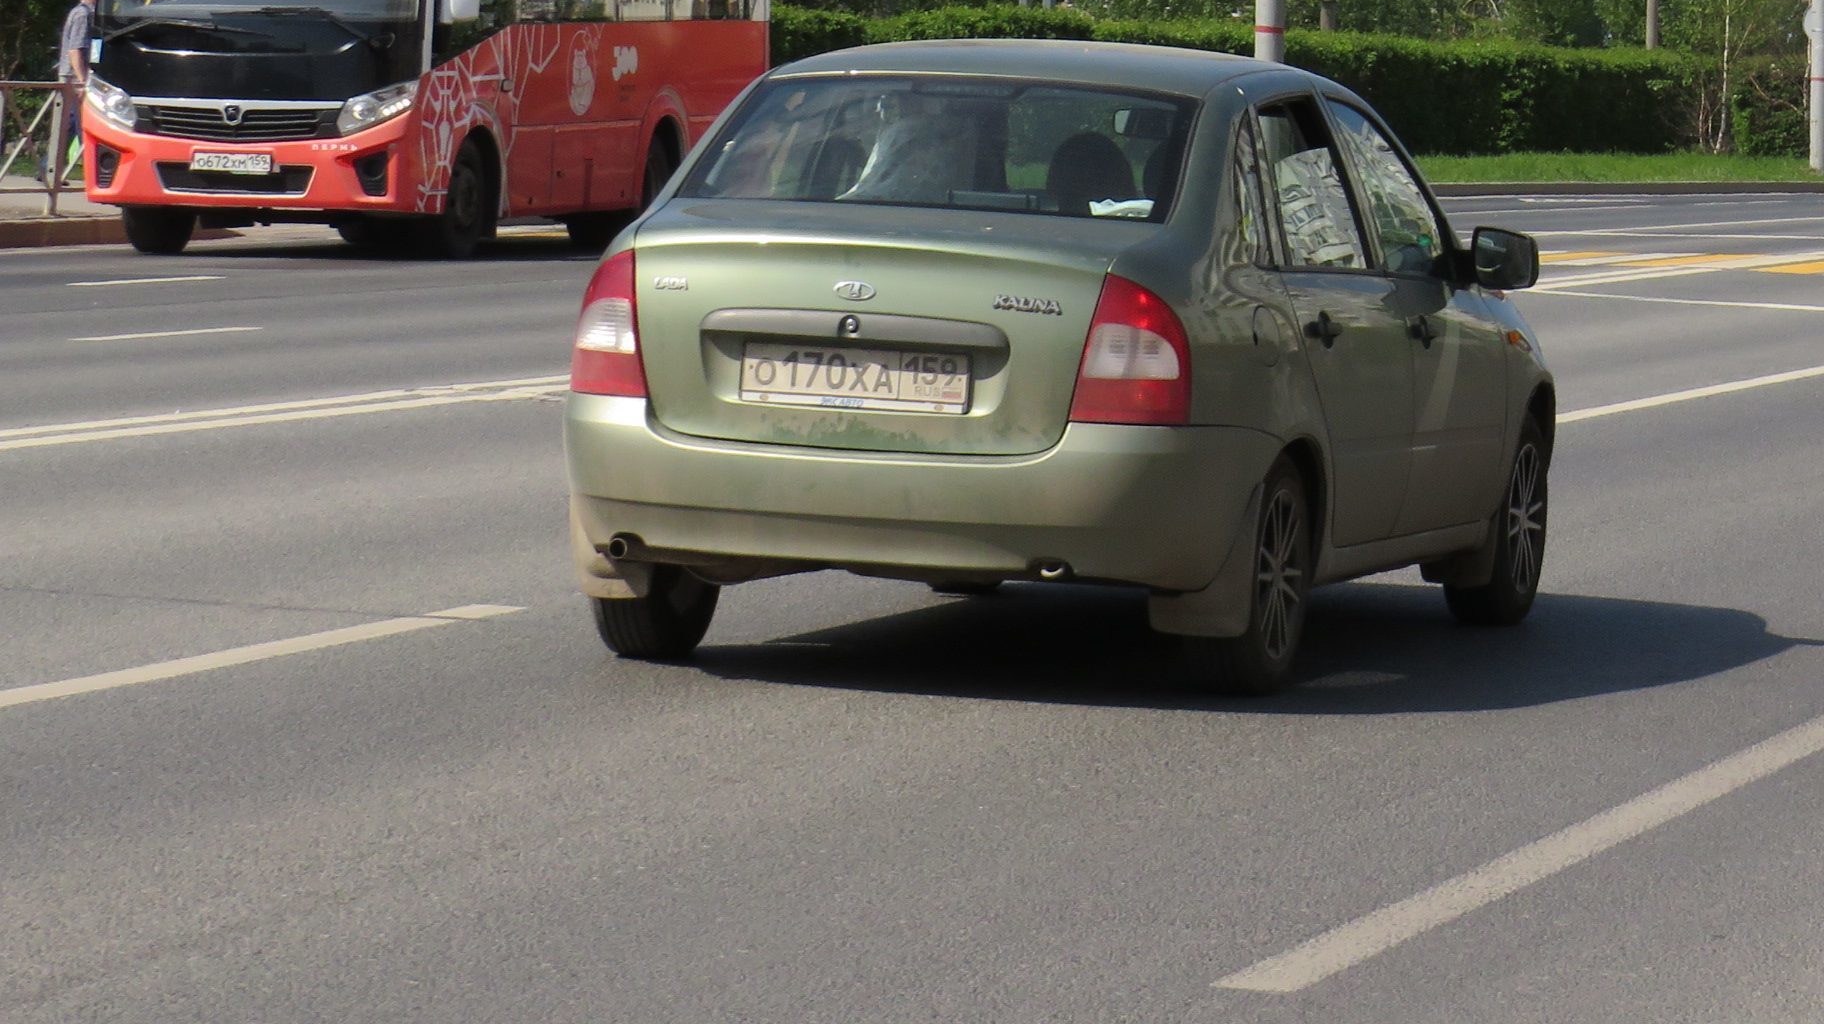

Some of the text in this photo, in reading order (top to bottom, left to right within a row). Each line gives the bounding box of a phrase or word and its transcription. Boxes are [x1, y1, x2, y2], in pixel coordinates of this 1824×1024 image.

[311, 143, 358, 152] ПЕРМЬ
[249, 155, 267, 167] 159
[653, 276, 689, 291] LADA
[992, 294, 1063, 316] KALINA
[904, 355, 959, 387] 159
[913, 386, 942, 399] RUS
